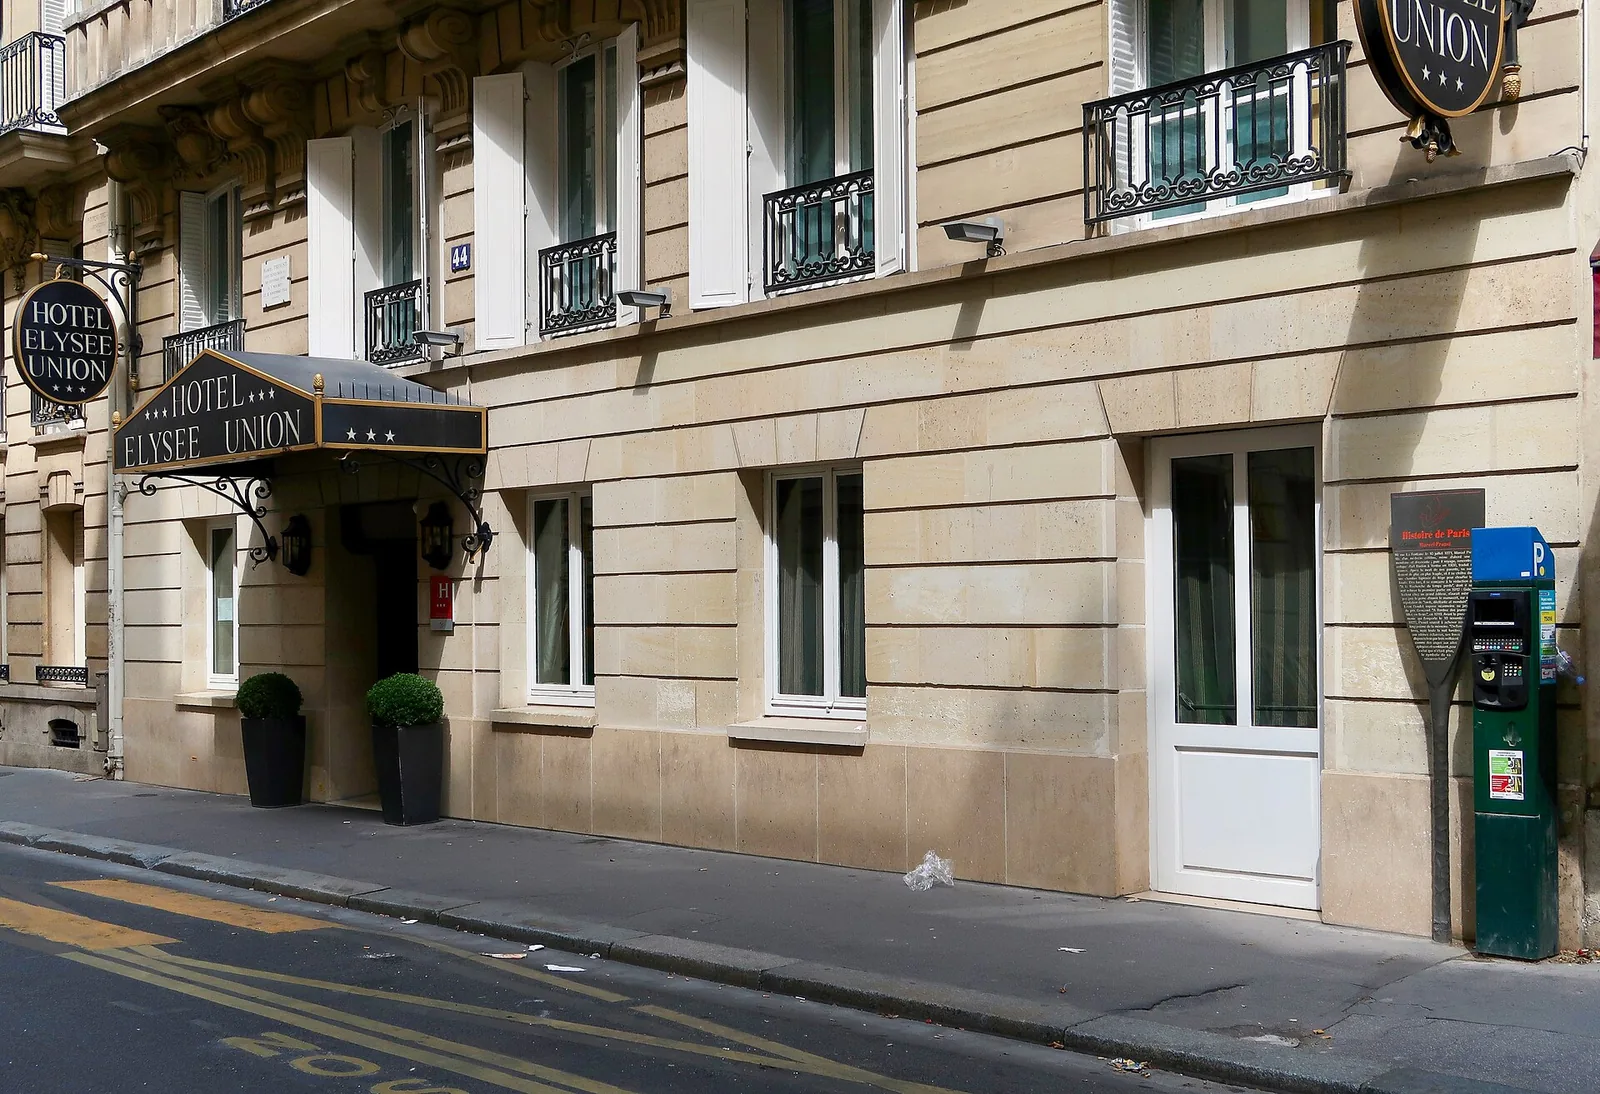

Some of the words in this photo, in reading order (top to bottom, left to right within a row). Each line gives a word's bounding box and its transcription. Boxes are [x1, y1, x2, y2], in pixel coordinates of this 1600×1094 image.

[1392, 0, 1489, 72] UNION
[453, 246, 468, 267] 44
[32, 300, 110, 330] HOTEL
[24, 328, 113, 356] ELYSEE
[28, 354, 106, 382] UNION
[171, 373, 245, 418] HOTEL
[124, 425, 201, 468] ELYSEE
[224, 408, 301, 454] UNION
[1402, 530, 1433, 540] Histoire
[1435, 528, 1445, 539] de
[1446, 528, 1471, 538] Paris
[1533, 542, 1545, 577] P
[439, 582, 449, 599] H
